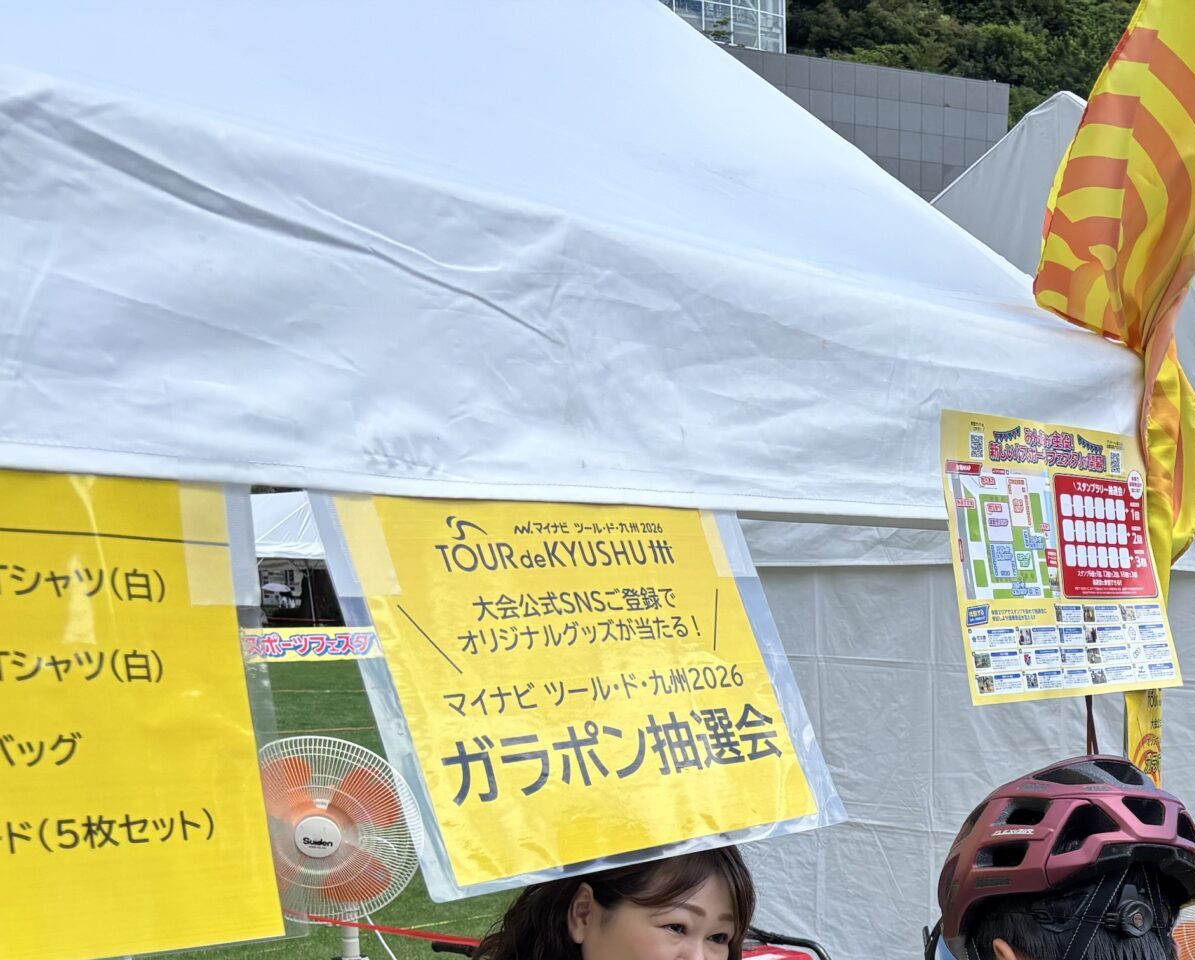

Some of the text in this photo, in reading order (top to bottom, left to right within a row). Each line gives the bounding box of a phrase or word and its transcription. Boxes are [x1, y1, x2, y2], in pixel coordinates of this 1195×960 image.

[533, 522, 570, 534] マイナビ
[642, 522, 663, 534] 2026
[435, 539, 647, 573] TOUR de KYUSHU
[472, 587, 676, 622] 大会公式SNSご登録で
[246, 633, 373, 657] スポーツフェスタ
[457, 615, 701, 655] オリジナルグッズが当たる！
[443, 664, 744, 717] マイナビ ツール・ド・九州2026
[441, 703, 783, 806] ガラポン抽選会
[0, 808, 214, 855] ド（5枚セット）
[303, 837, 333, 847] Suiden
